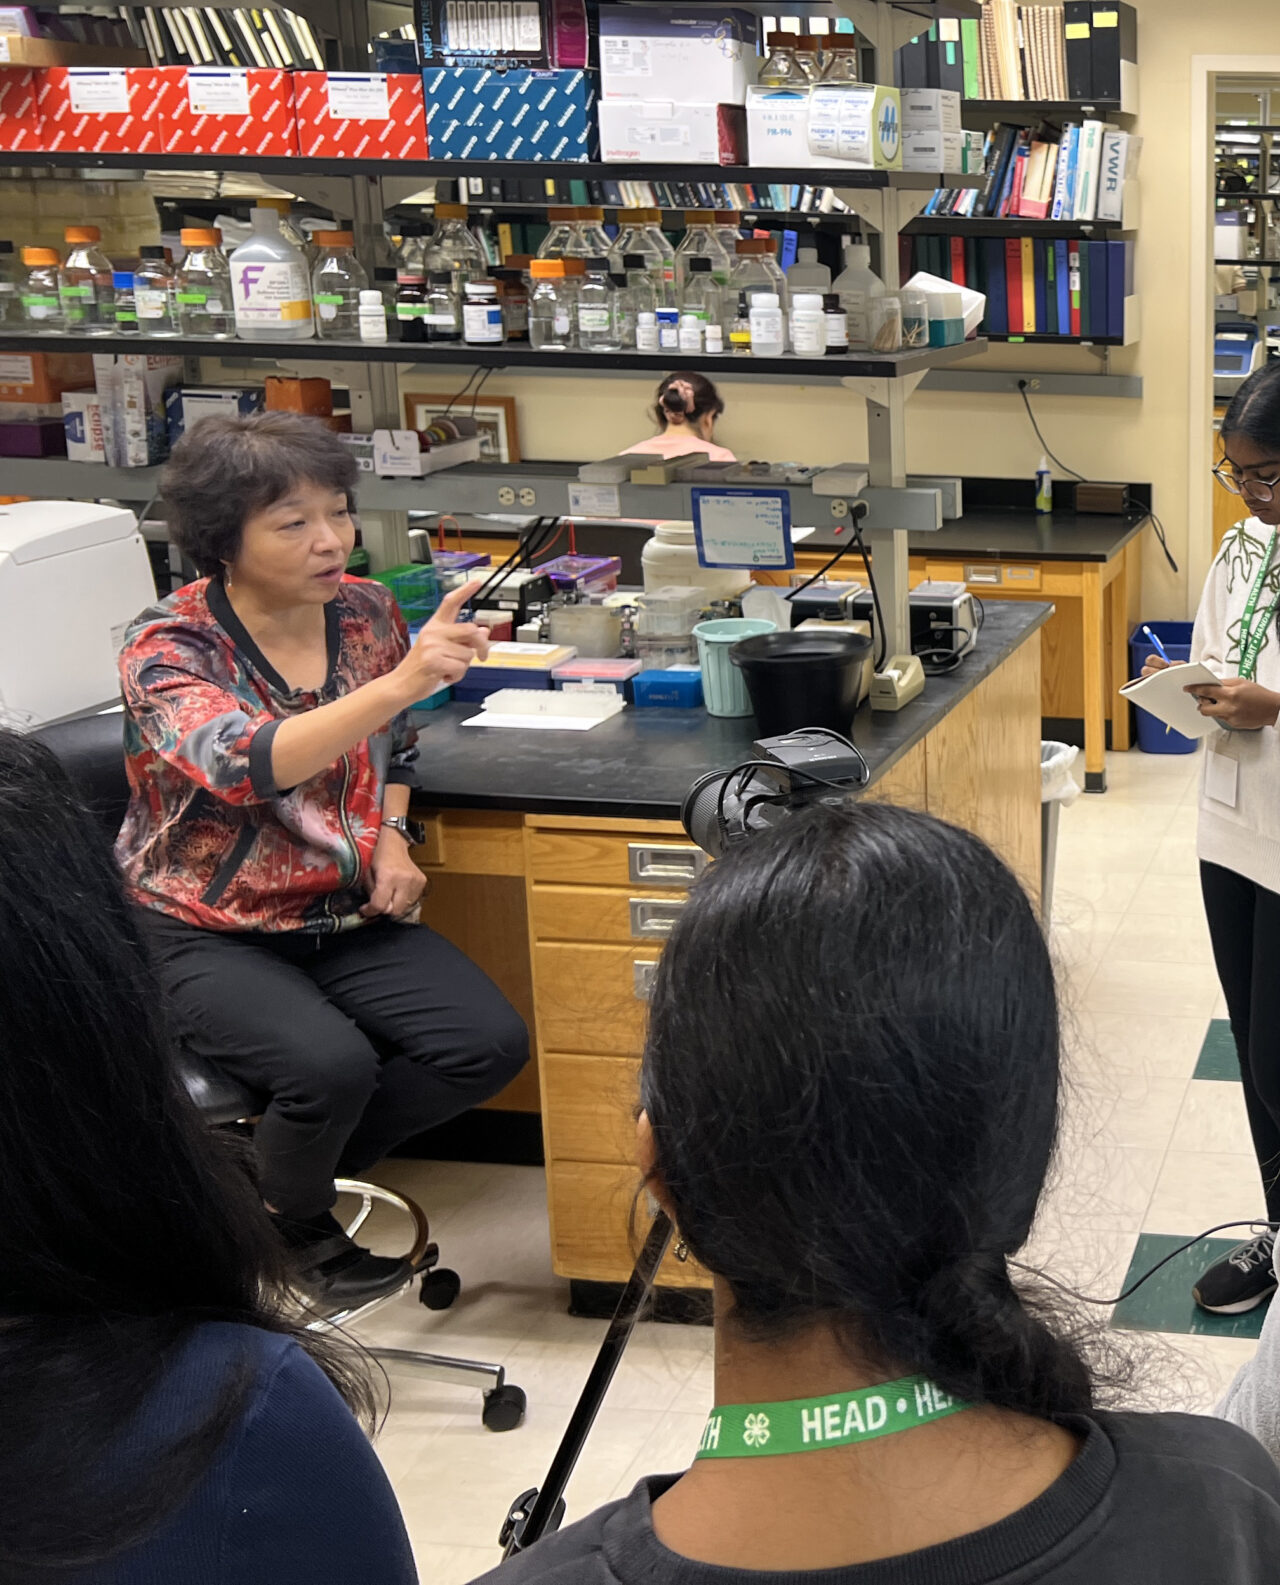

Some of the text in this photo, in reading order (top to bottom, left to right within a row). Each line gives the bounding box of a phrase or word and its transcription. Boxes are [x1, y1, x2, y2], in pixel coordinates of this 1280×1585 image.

[1106, 141, 1120, 192] VWR
[1243, 644, 1258, 670] HEART
[1255, 612, 1272, 640] HANDS
[801, 1396, 887, 1443] HEAD
